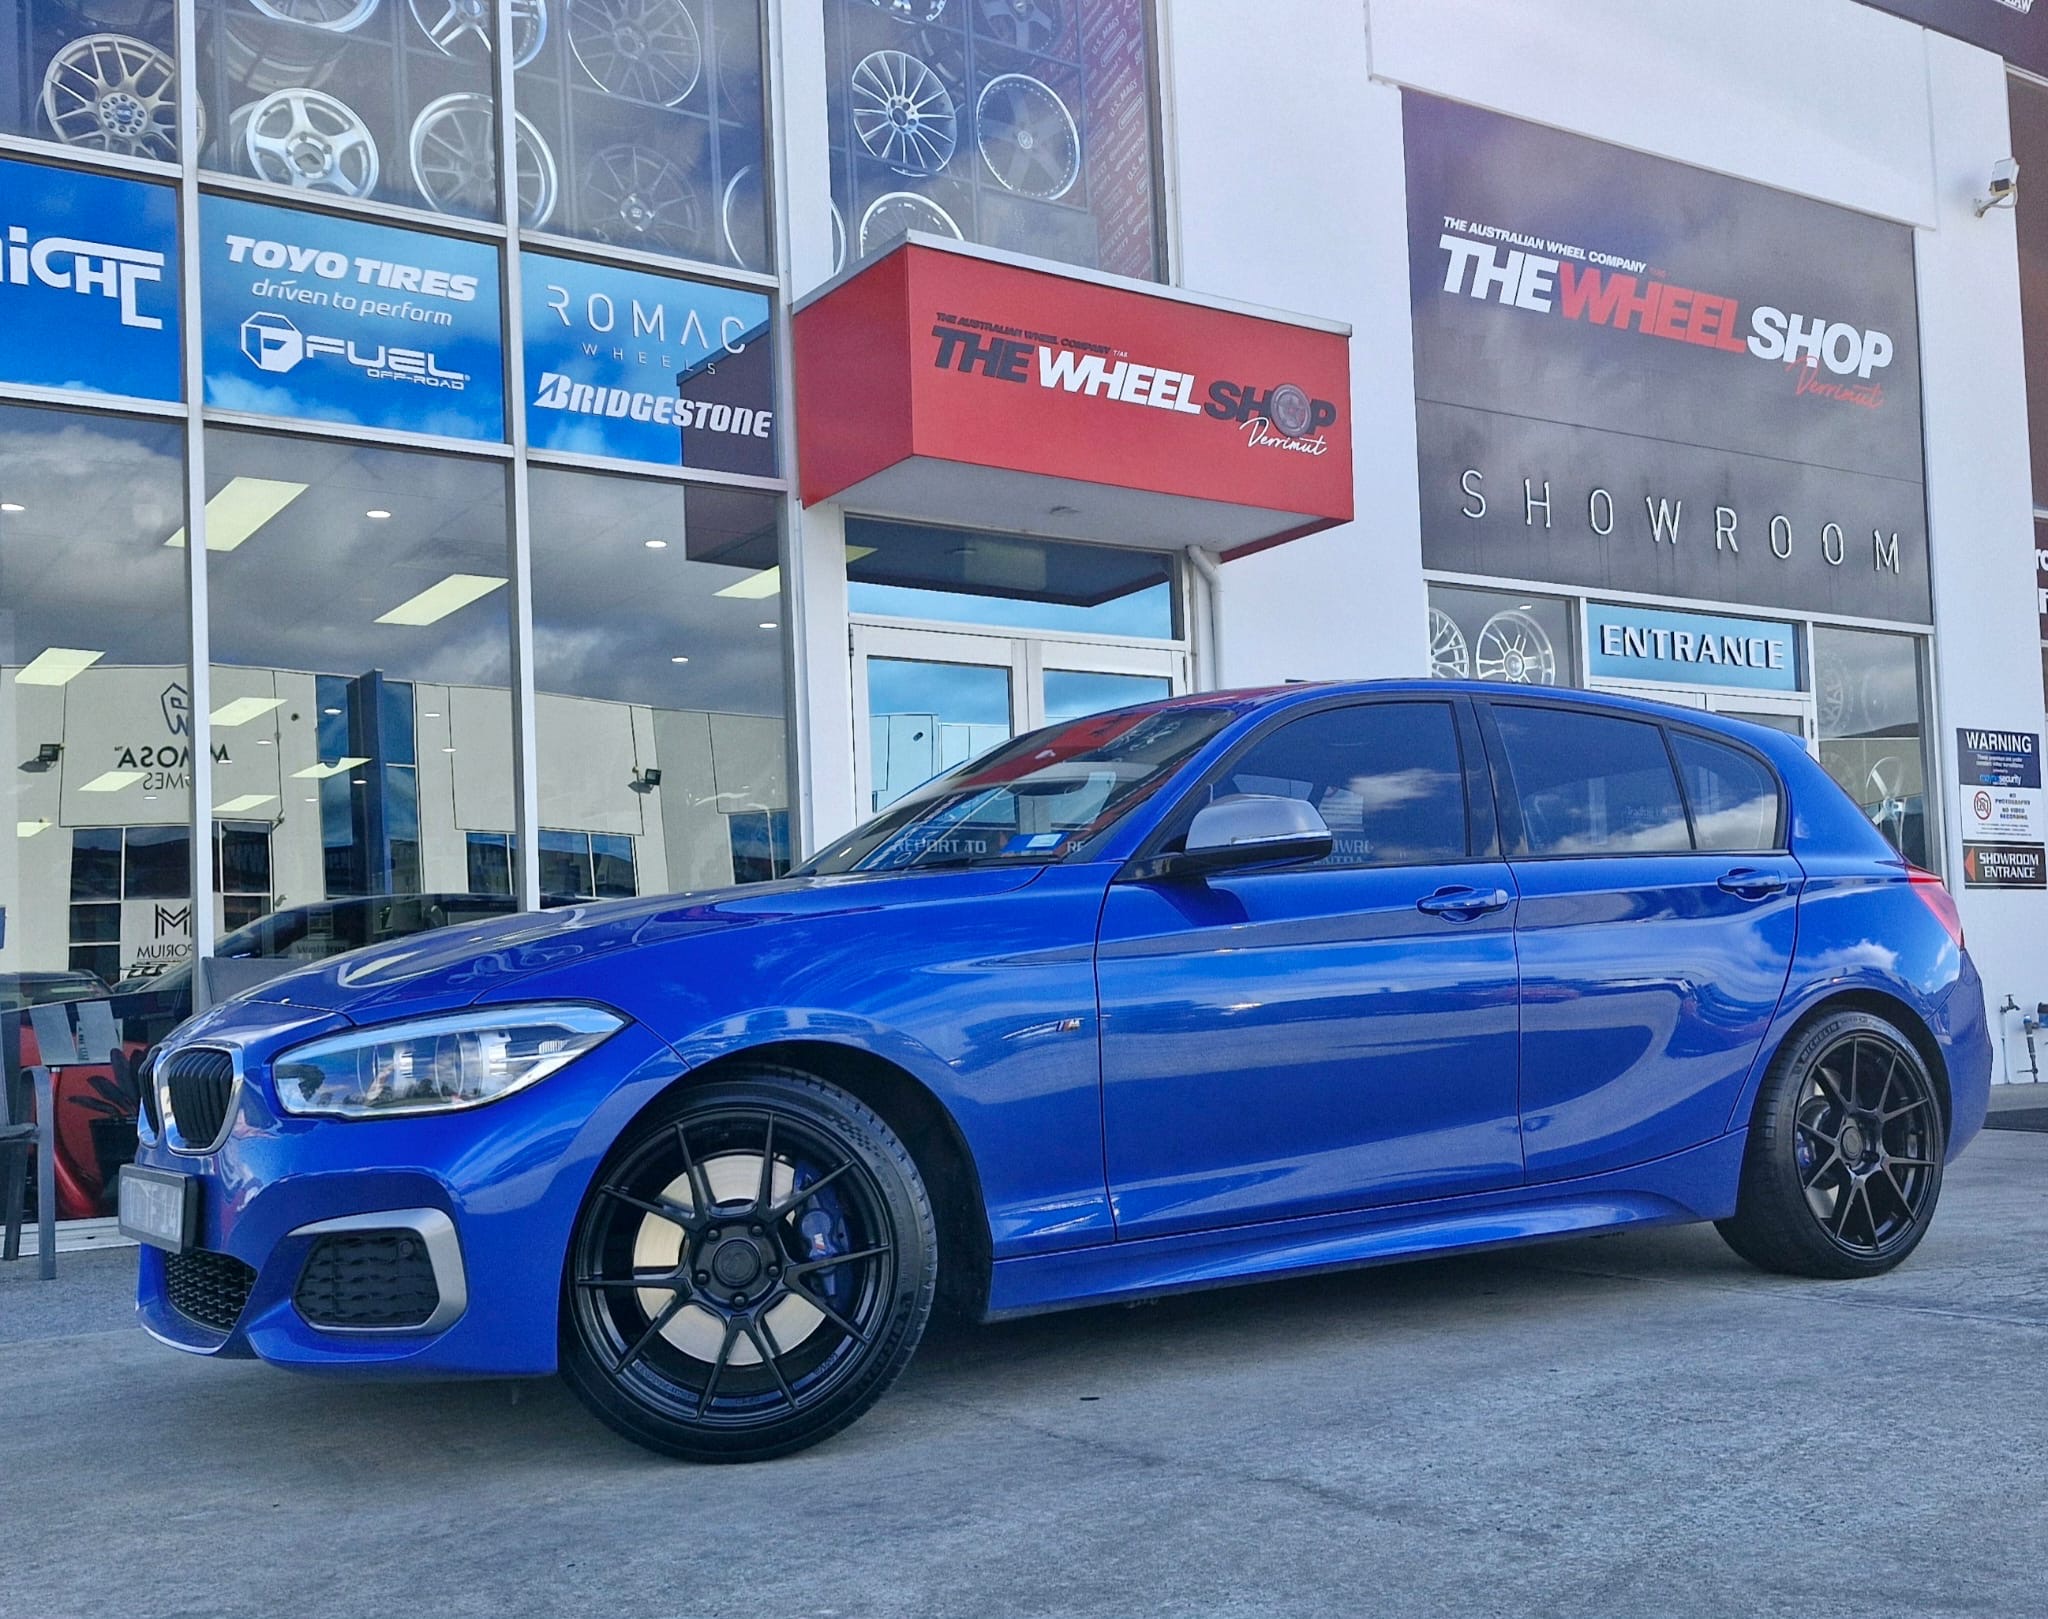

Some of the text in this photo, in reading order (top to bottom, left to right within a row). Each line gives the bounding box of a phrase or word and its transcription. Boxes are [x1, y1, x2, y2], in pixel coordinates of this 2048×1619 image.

[1443, 215, 1468, 232] THE
[1468, 221, 1545, 251] AUSTRALIAN
[1546, 240, 1587, 261] WHEEL
[1588, 251, 1648, 273] COMPANY
[226, 235, 479, 302] TOYO TIRES
[332, 291, 357, 311] to
[359, 299, 453, 327] perform
[547, 284, 747, 354] ROMAC
[1439, 233, 1894, 379] THE WHEEL SHOP
[936, 312, 957, 325] THE
[957, 318, 1023, 339] AUSTRALIAN
[1024, 330, 1059, 346] WHEEL
[1060, 338, 1111, 355] COMPANY
[582, 341, 717, 375] WHEELS
[932, 325, 1036, 384] THE
[1038, 345, 1202, 416] WHEEL
[366, 368, 465, 391] OFF-ROAD
[533, 372, 774, 439] BRIDGESTONE
[1239, 416, 1328, 456] Derrimut
[1461, 469, 1901, 575] SHOWROOM
[1600, 623, 1785, 670] ENTRANCE
[1965, 730, 2032, 754] WARNING
[964, 840, 987, 854] TO
[1979, 852, 2039, 866] SHOWROOM
[1984, 866, 2036, 878] ENTRANCE
[1800, 1021, 1841, 1062] MICHELIN
